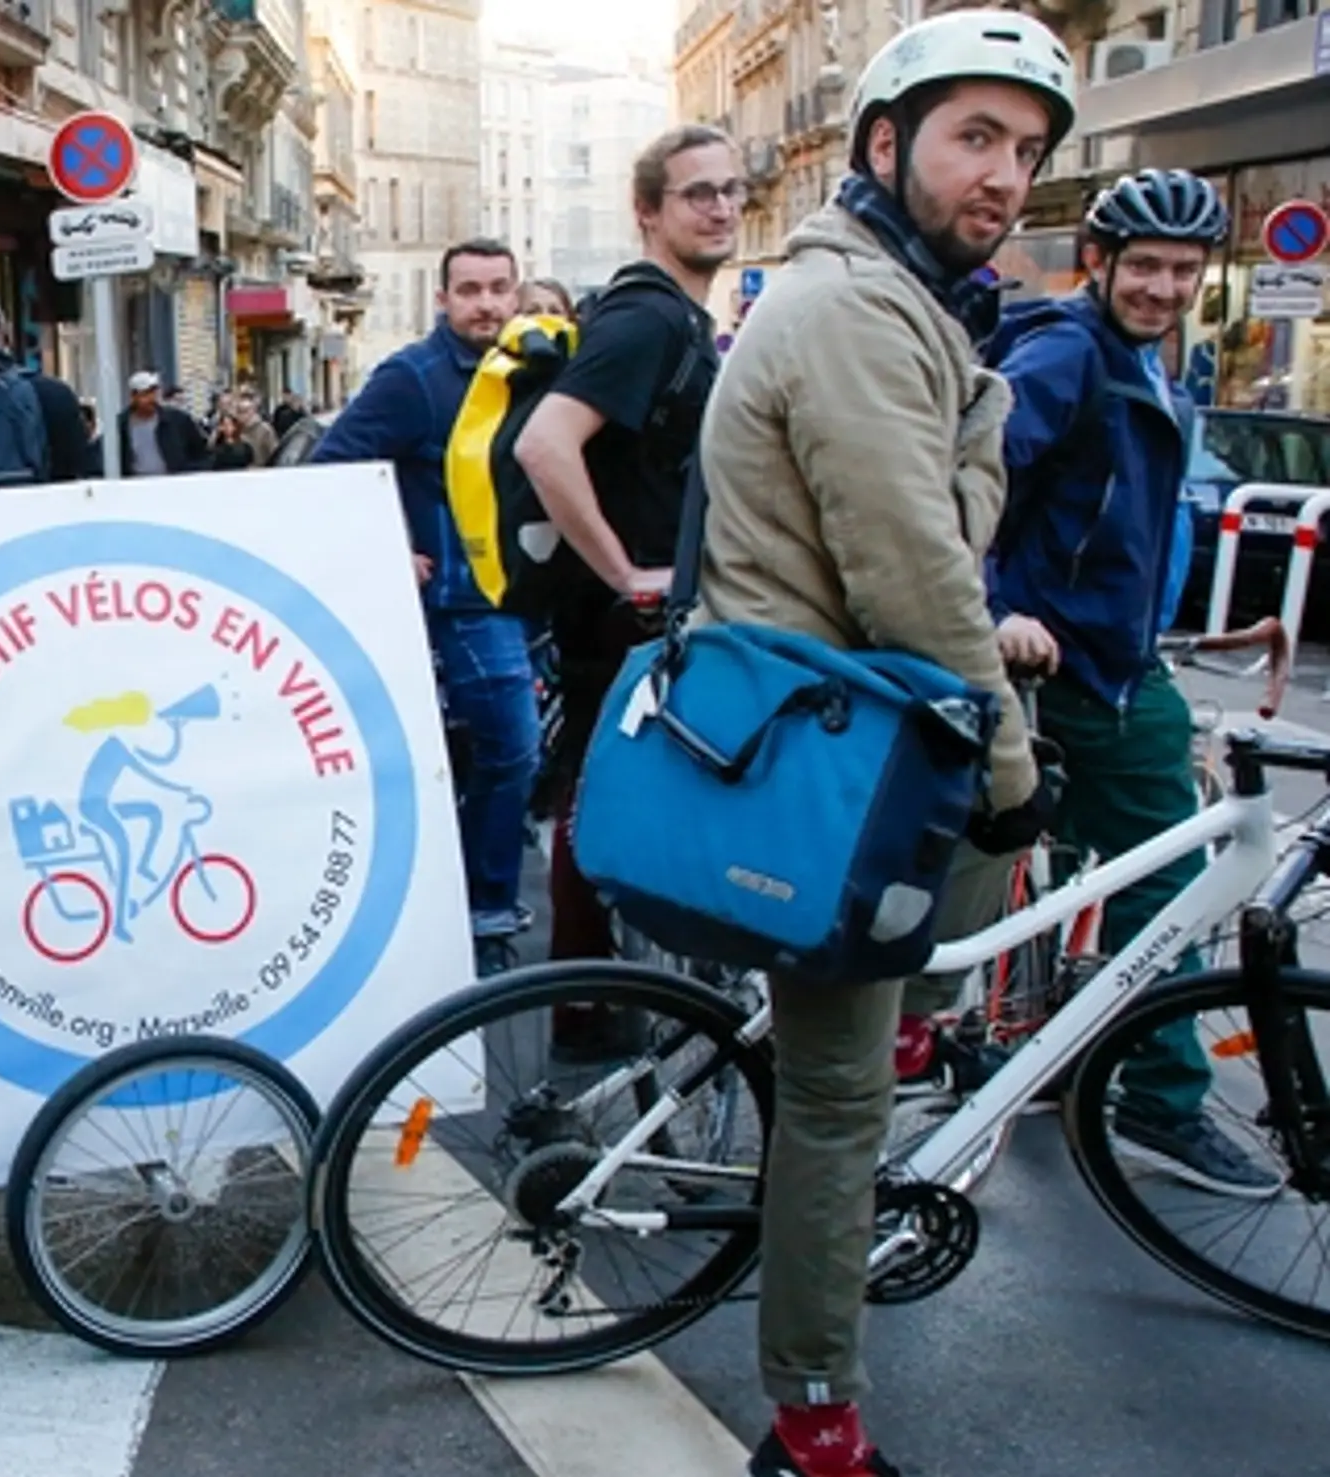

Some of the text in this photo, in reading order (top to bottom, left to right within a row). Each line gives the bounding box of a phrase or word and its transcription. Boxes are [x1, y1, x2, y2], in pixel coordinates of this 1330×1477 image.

[45, 569, 202, 630] VÉLOS
[211, 605, 280, 671] EN
[278, 659, 355, 778] VILLE
[330, 809, 358, 846] 77
[323, 849, 354, 887] 88
[310, 888, 342, 926] 58
[286, 922, 321, 962] 54
[258, 951, 292, 990] 09
[137, 989, 250, 1040] Marseille
